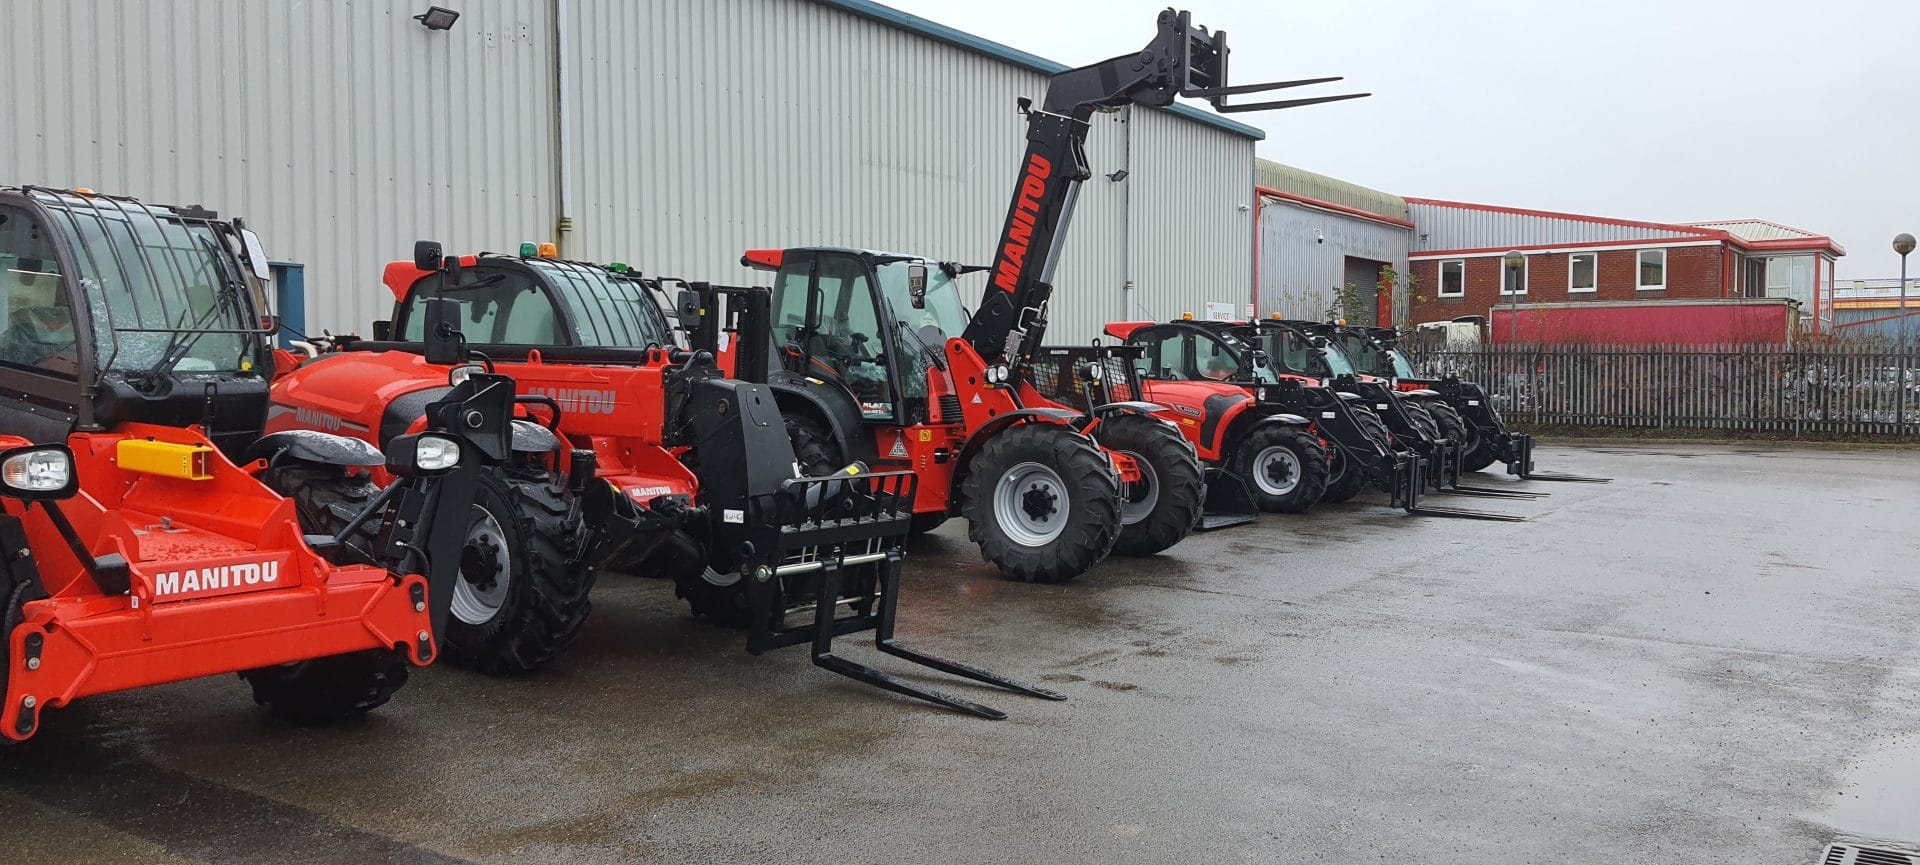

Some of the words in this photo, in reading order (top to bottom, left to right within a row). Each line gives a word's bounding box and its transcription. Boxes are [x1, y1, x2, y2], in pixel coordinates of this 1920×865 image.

[994, 153, 1052, 294] MANITOU
[1213, 311, 1230, 320] SERVICE
[296, 406, 341, 432] MANITOU
[631, 485, 672, 497] MANITOU
[155, 560, 278, 596] MANITOU
